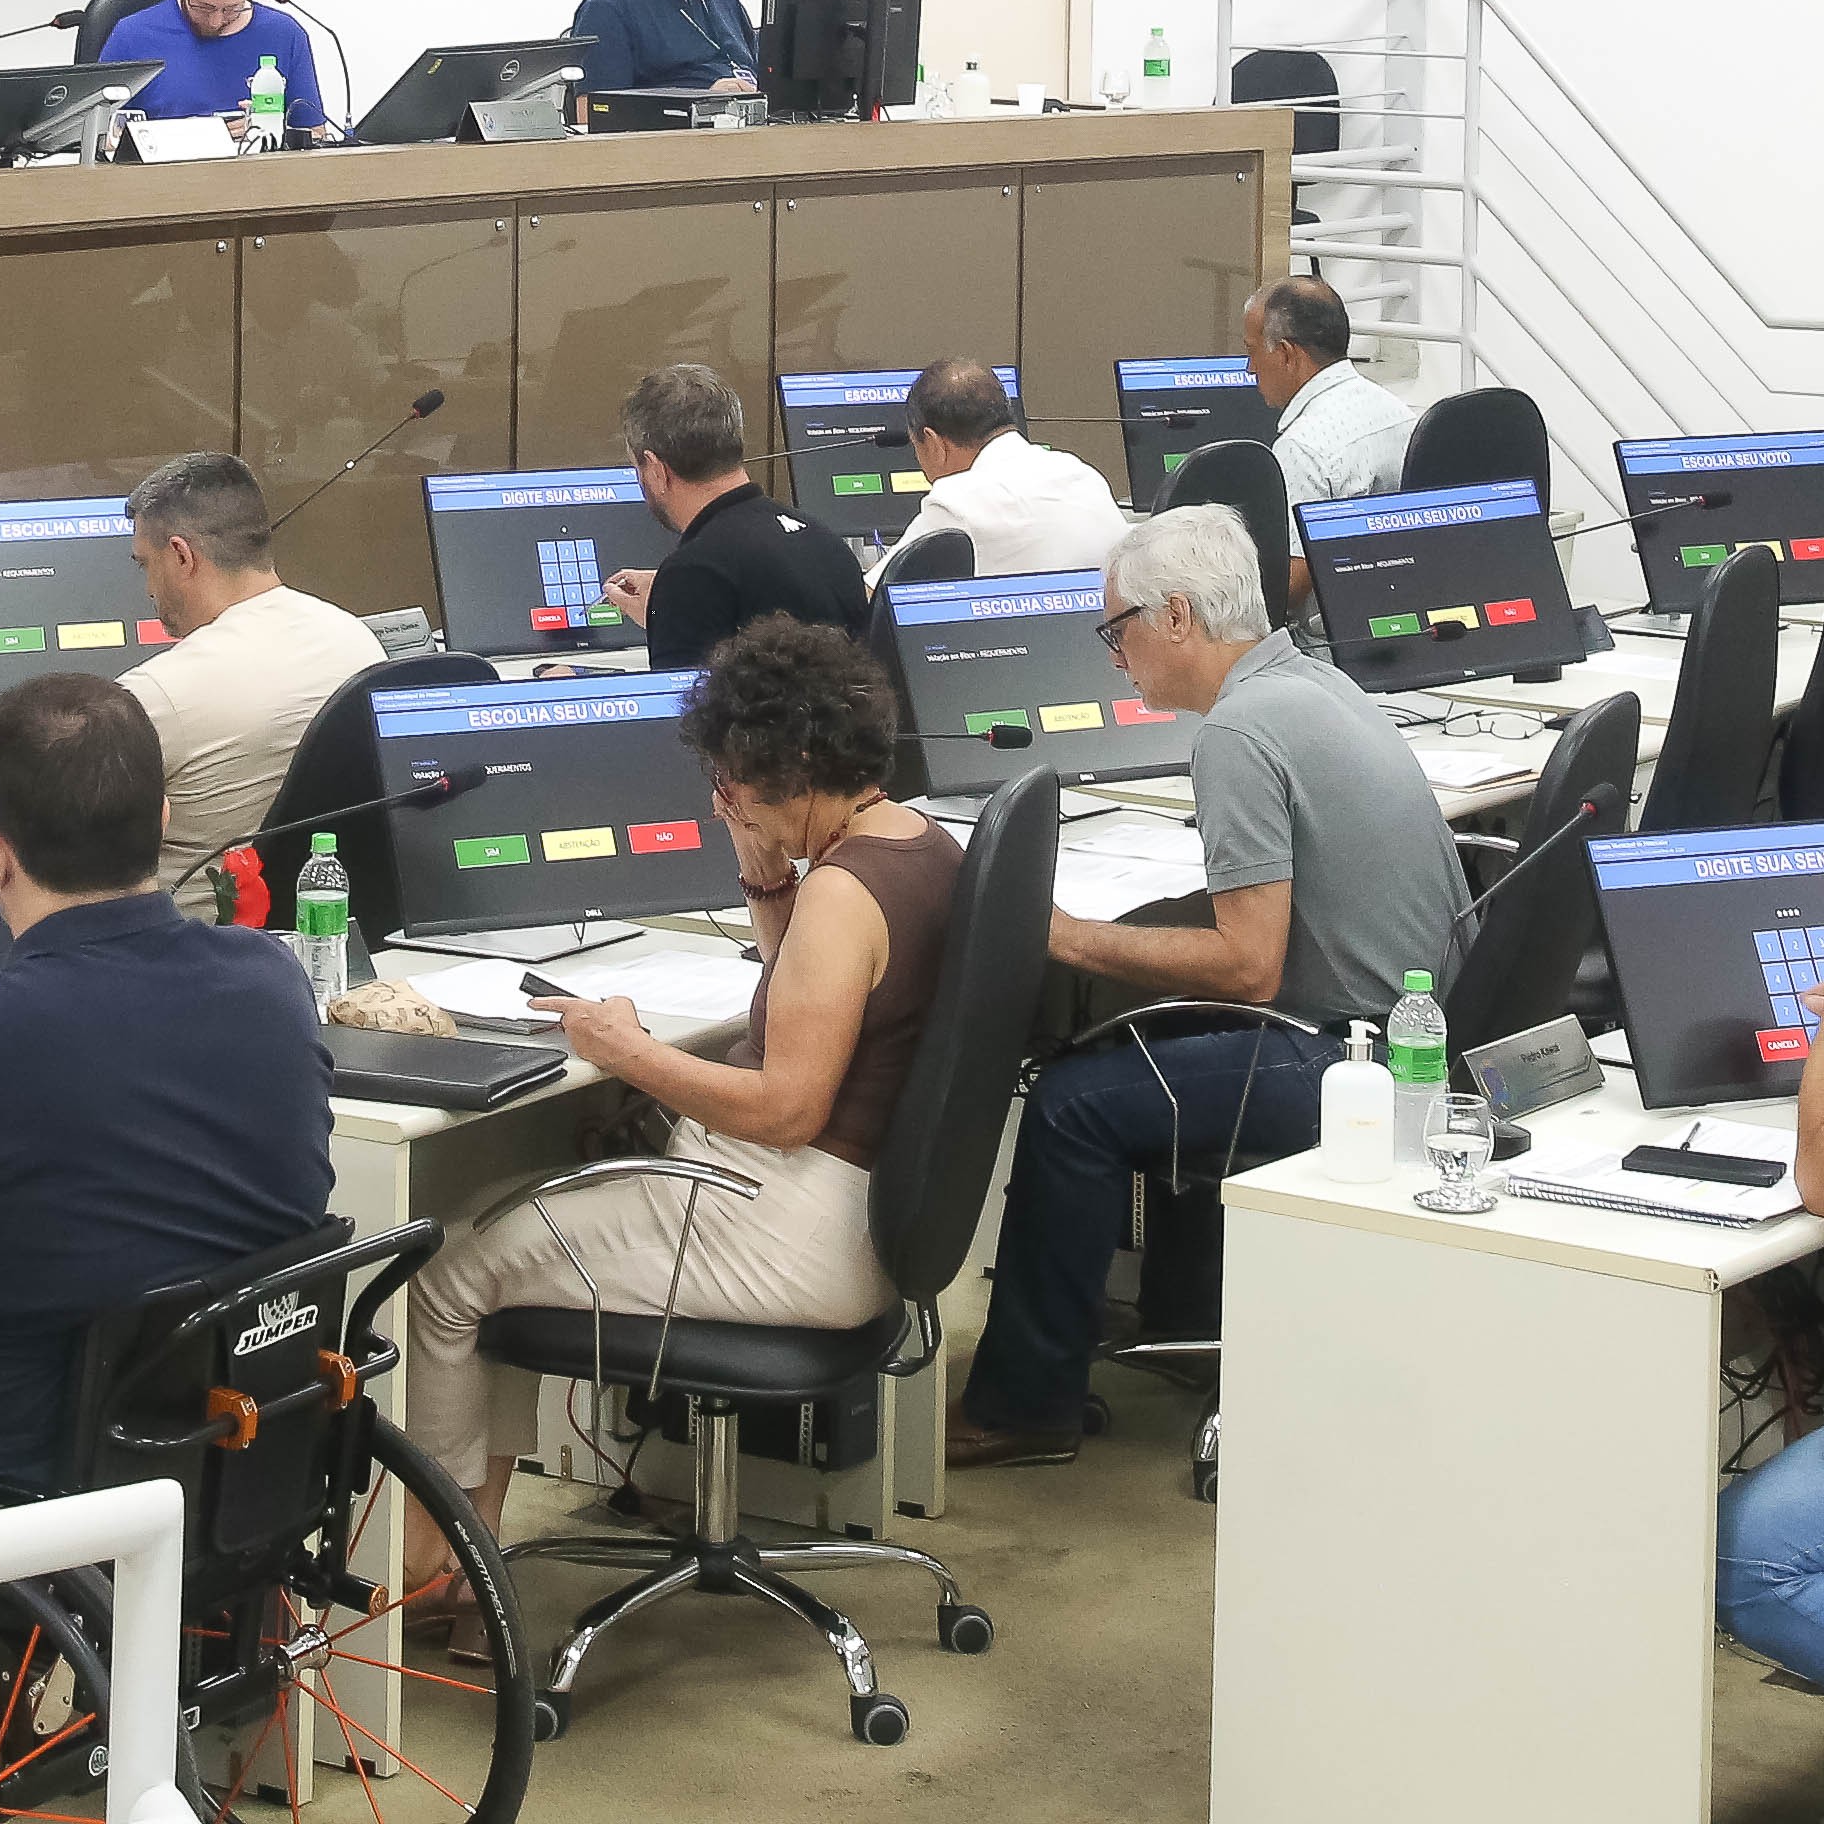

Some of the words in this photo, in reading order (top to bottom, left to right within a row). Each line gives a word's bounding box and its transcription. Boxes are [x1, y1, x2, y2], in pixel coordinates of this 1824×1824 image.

[1174, 374, 1221, 385] ESCOLHA
[1224, 373, 1243, 384] SEU
[845, 388, 900, 401] ESCOLHA
[1681, 454, 1735, 469] ESCOLHA
[1736, 453, 1758, 465] SEU
[1760, 451, 1791, 464] VOTO
[502, 490, 544, 504] DIGITE
[546, 490, 573, 503] SUA
[574, 488, 617, 501] SENHA
[1367, 513, 1424, 530] ESCOLHA
[1424, 510, 1451, 525] SEU
[1452, 506, 1482, 521] VOTO
[0, 520, 78, 538] ESCOLHA
[80, 519, 111, 533] SEU
[971, 597, 1042, 616] ESCOLHA
[1044, 595, 1074, 611] SEU
[1078, 592, 1104, 608] VOT
[467, 703, 552, 727] ESCOLHA
[554, 703, 589, 721] SEU
[594, 699, 639, 718] VOTO
[655, 831, 675, 842] NÃO
[1694, 859, 1753, 878] DIGITE
[1756, 856, 1793, 873] SUA
[1767, 1040, 1800, 1051] CANCELA
[239, 1309, 316, 1352] JUMPER
